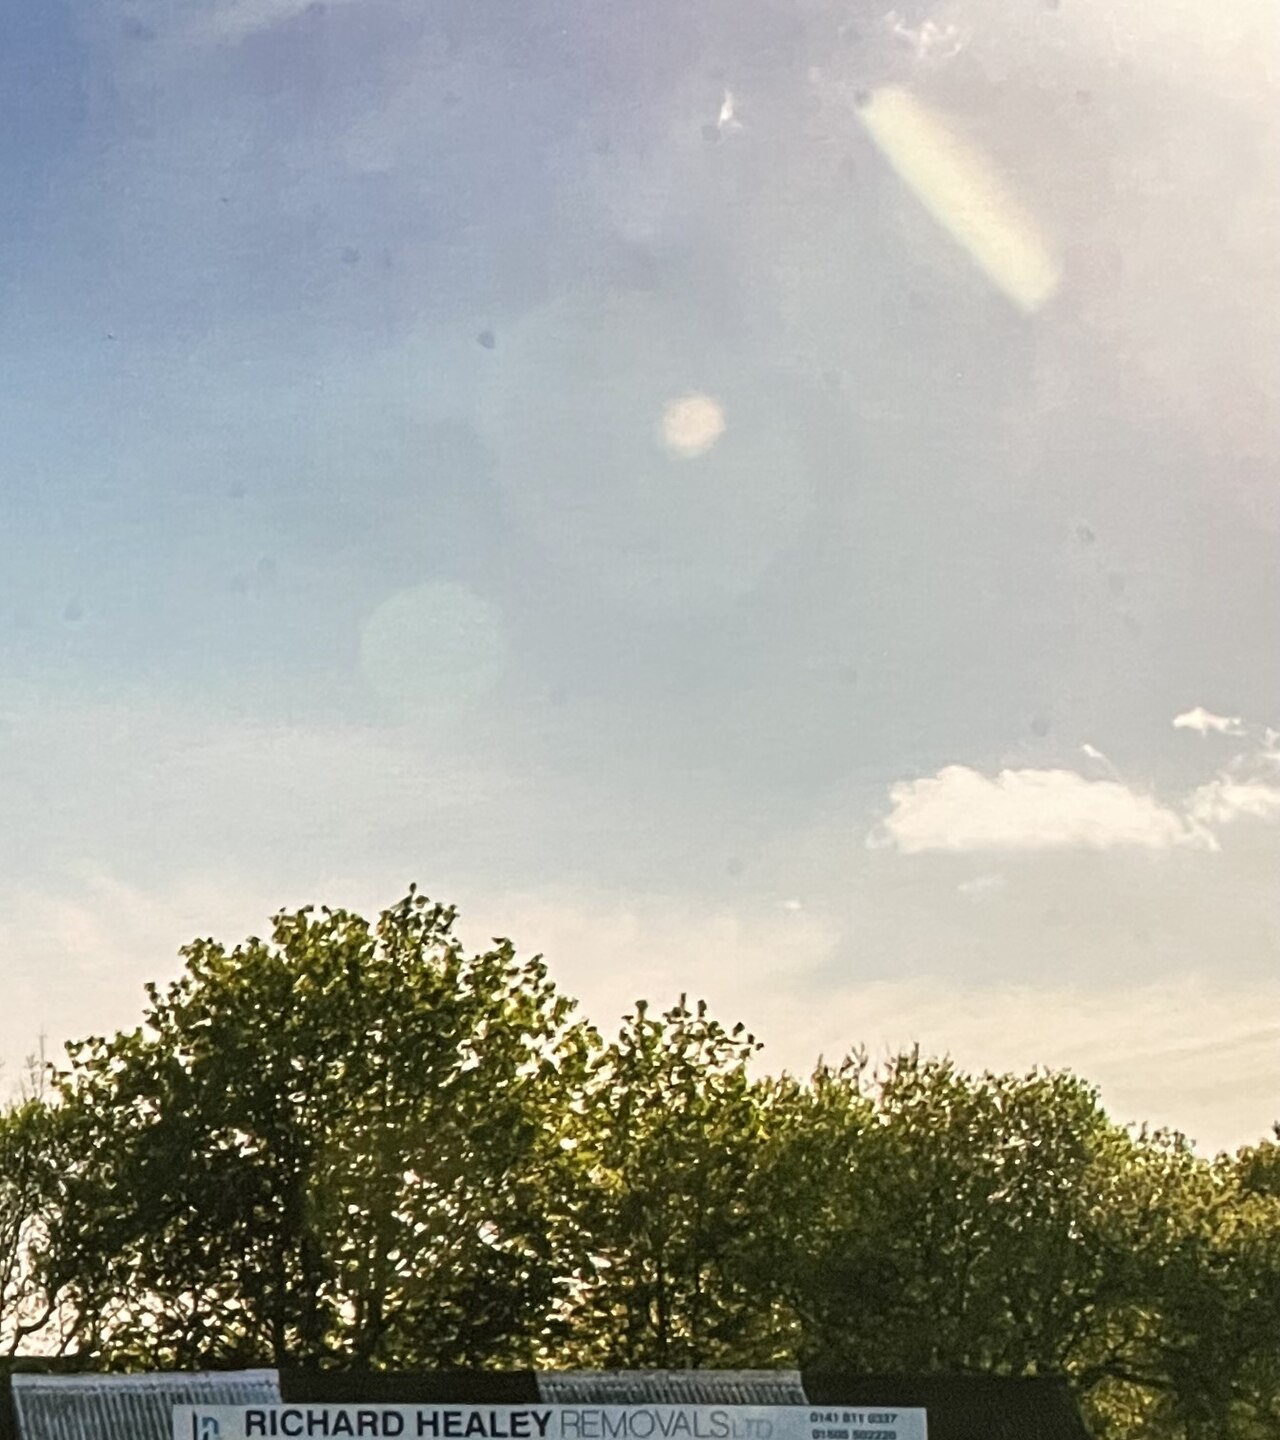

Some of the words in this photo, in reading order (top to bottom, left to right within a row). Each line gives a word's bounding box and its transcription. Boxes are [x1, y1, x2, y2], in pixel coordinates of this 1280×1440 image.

[245, 1410, 404, 1437] RICHARD
[416, 1411, 552, 1438] HEALEY
[561, 1410, 729, 1438] REMOVALS
[734, 1417, 773, 1439] LTD
[809, 1411, 839, 1423] 0141
